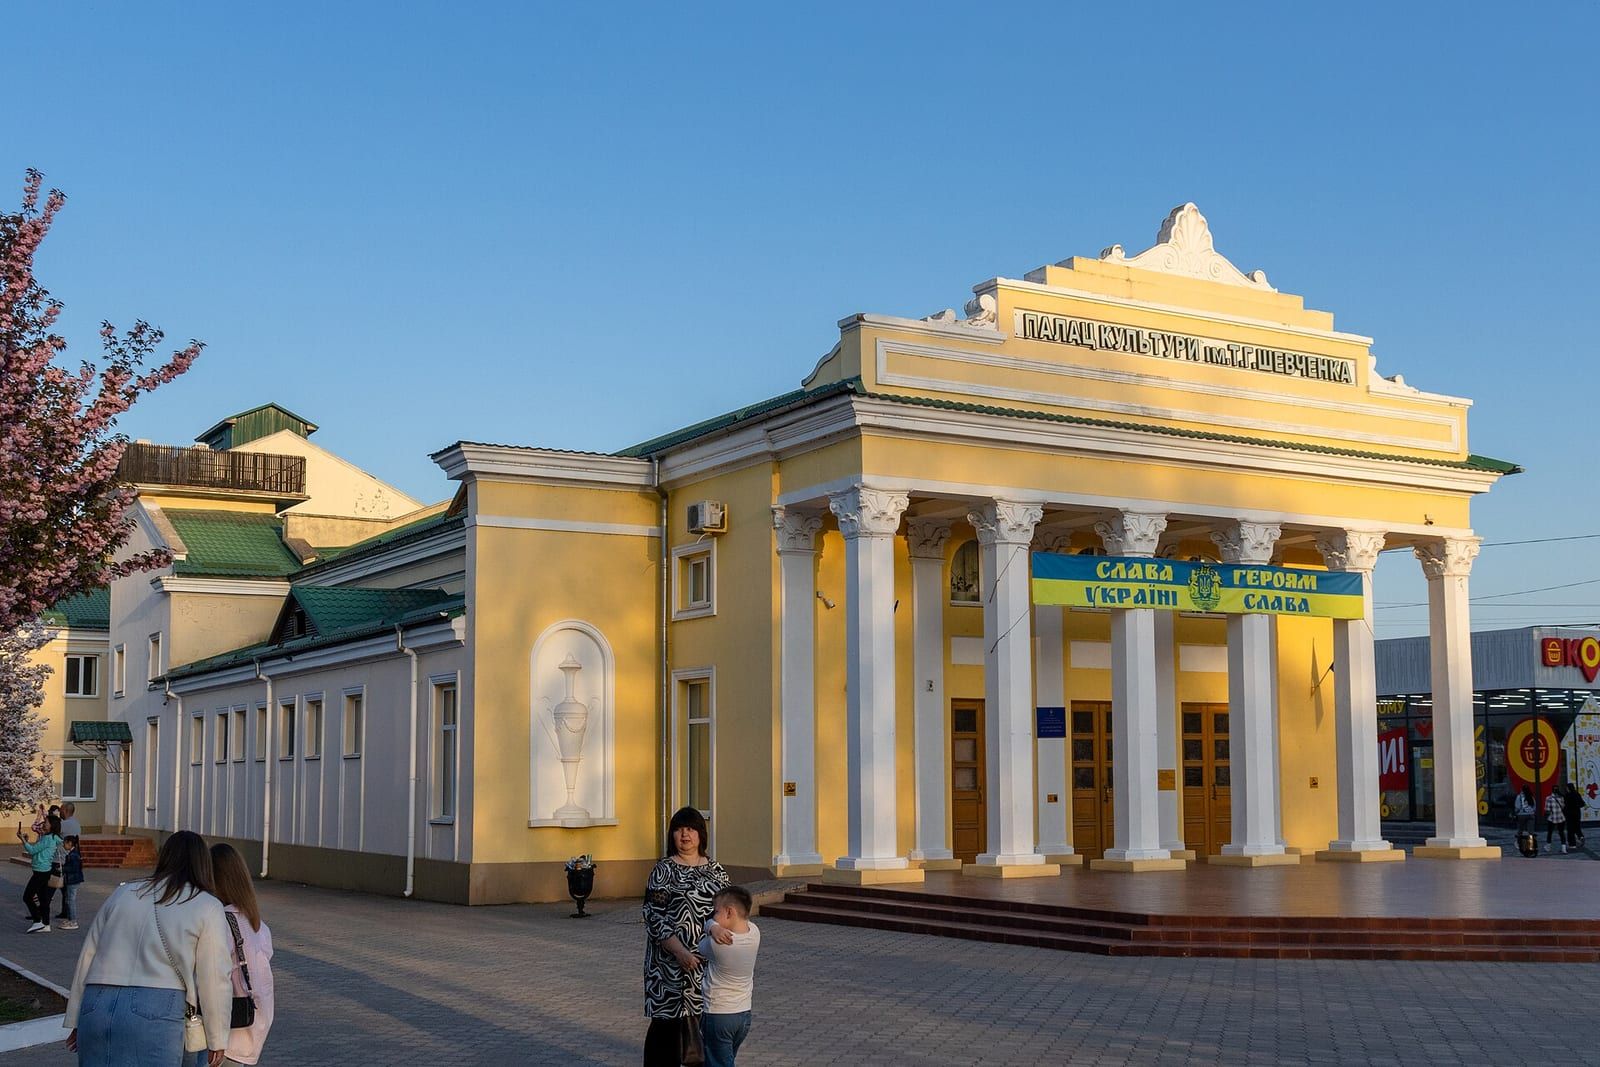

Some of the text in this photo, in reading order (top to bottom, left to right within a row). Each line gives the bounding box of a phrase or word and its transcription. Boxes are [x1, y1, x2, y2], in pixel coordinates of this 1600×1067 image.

[1023, 312, 1097, 350] ПАЛАЦ
[1098, 323, 1200, 361] КУЛЬТУРИ
[1096, 561, 1317, 591] СЛАВА ГЕРОЯМ
[1085, 584, 1310, 613] УКРАЇНІ СЛАВА
